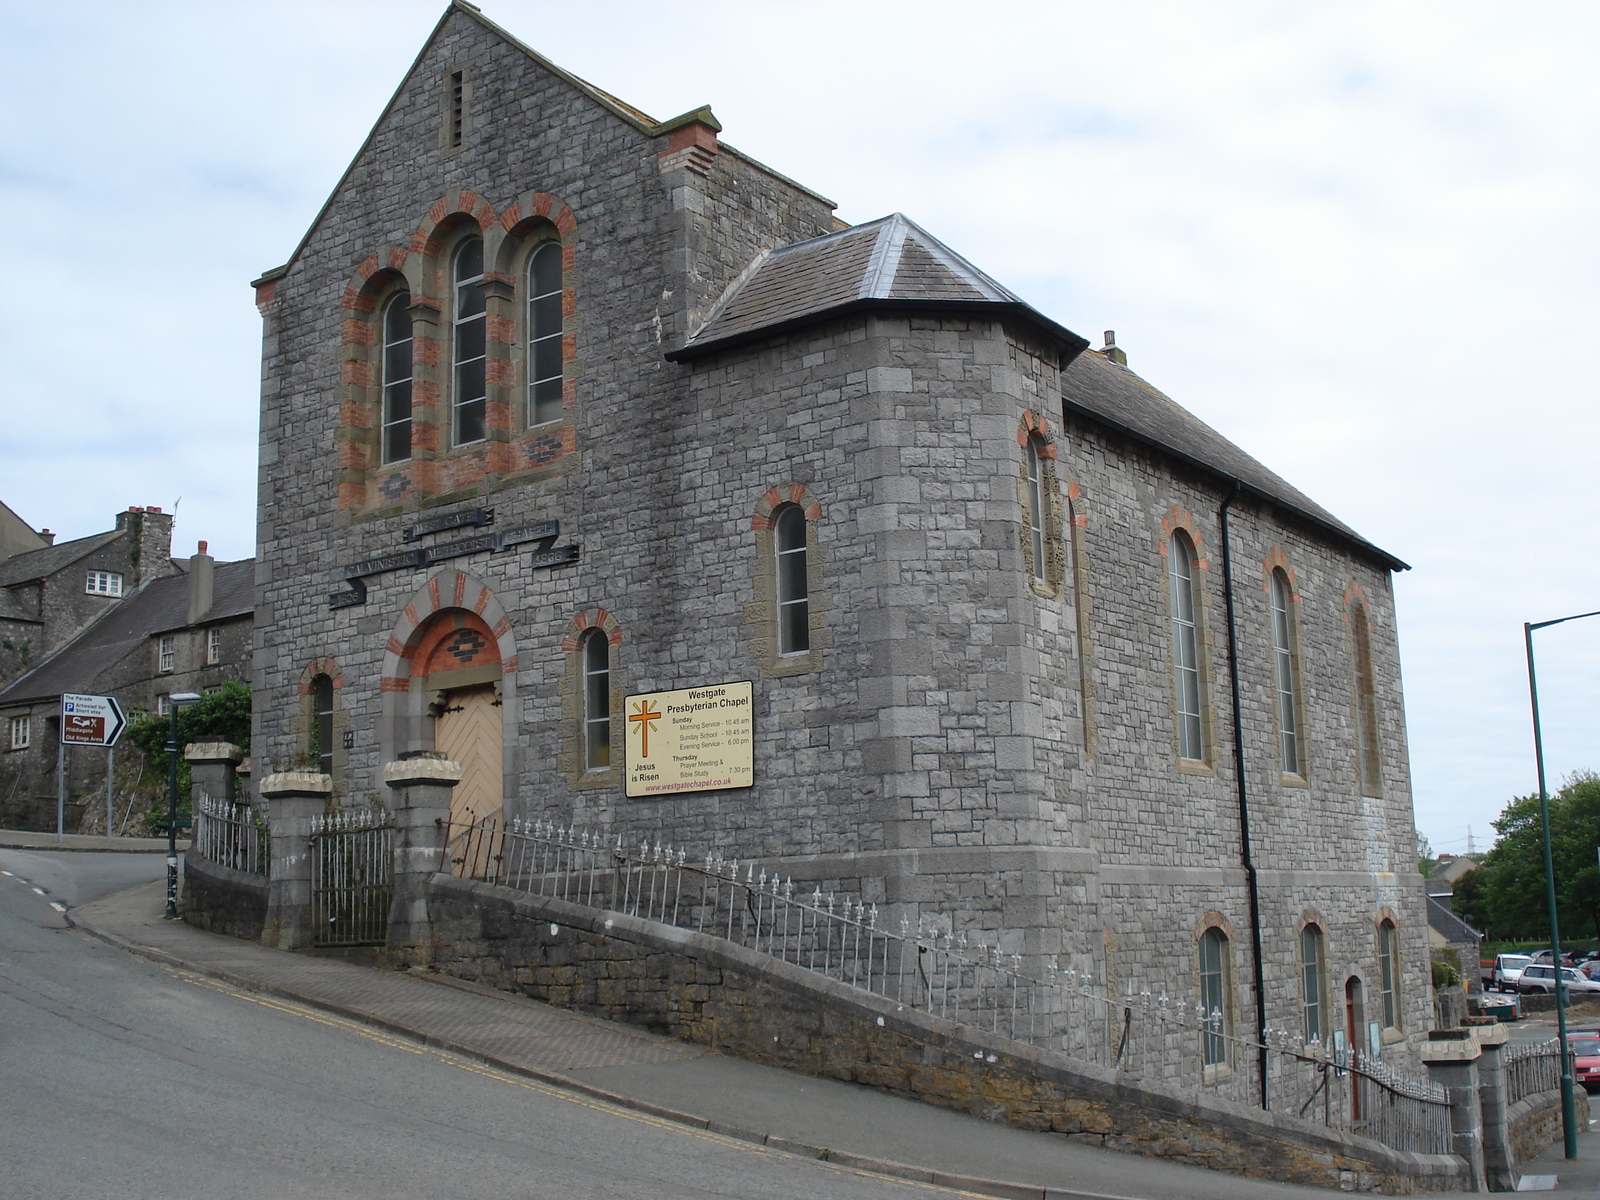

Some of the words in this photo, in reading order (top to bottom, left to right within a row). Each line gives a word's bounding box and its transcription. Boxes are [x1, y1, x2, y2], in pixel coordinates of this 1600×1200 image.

[415, 520, 441, 532] WEST
[346, 552, 414, 576] CALVINISTIC
[428, 536, 490, 558] METHODIST
[504, 524, 552, 542] CHAPEL
[688, 688, 726, 700] Westgate
[667, 702, 718, 714] Presbyterian
[720, 696, 748, 709] Chapel
[680, 722, 700, 731] Morning
[702, 721, 720, 729] Service
[700, 731, 718, 740] School
[680, 742, 700, 751] Evening
[702, 741, 720, 749] Service
[635, 763, 656, 772] Jesus
[680, 761, 697, 770] Prayer
[698, 760, 718, 768] Meeting
[639, 774, 659, 782] Risen
[694, 770, 709, 778] Study
[645, 777, 732, 792] www.westgatechapel.co.uk
